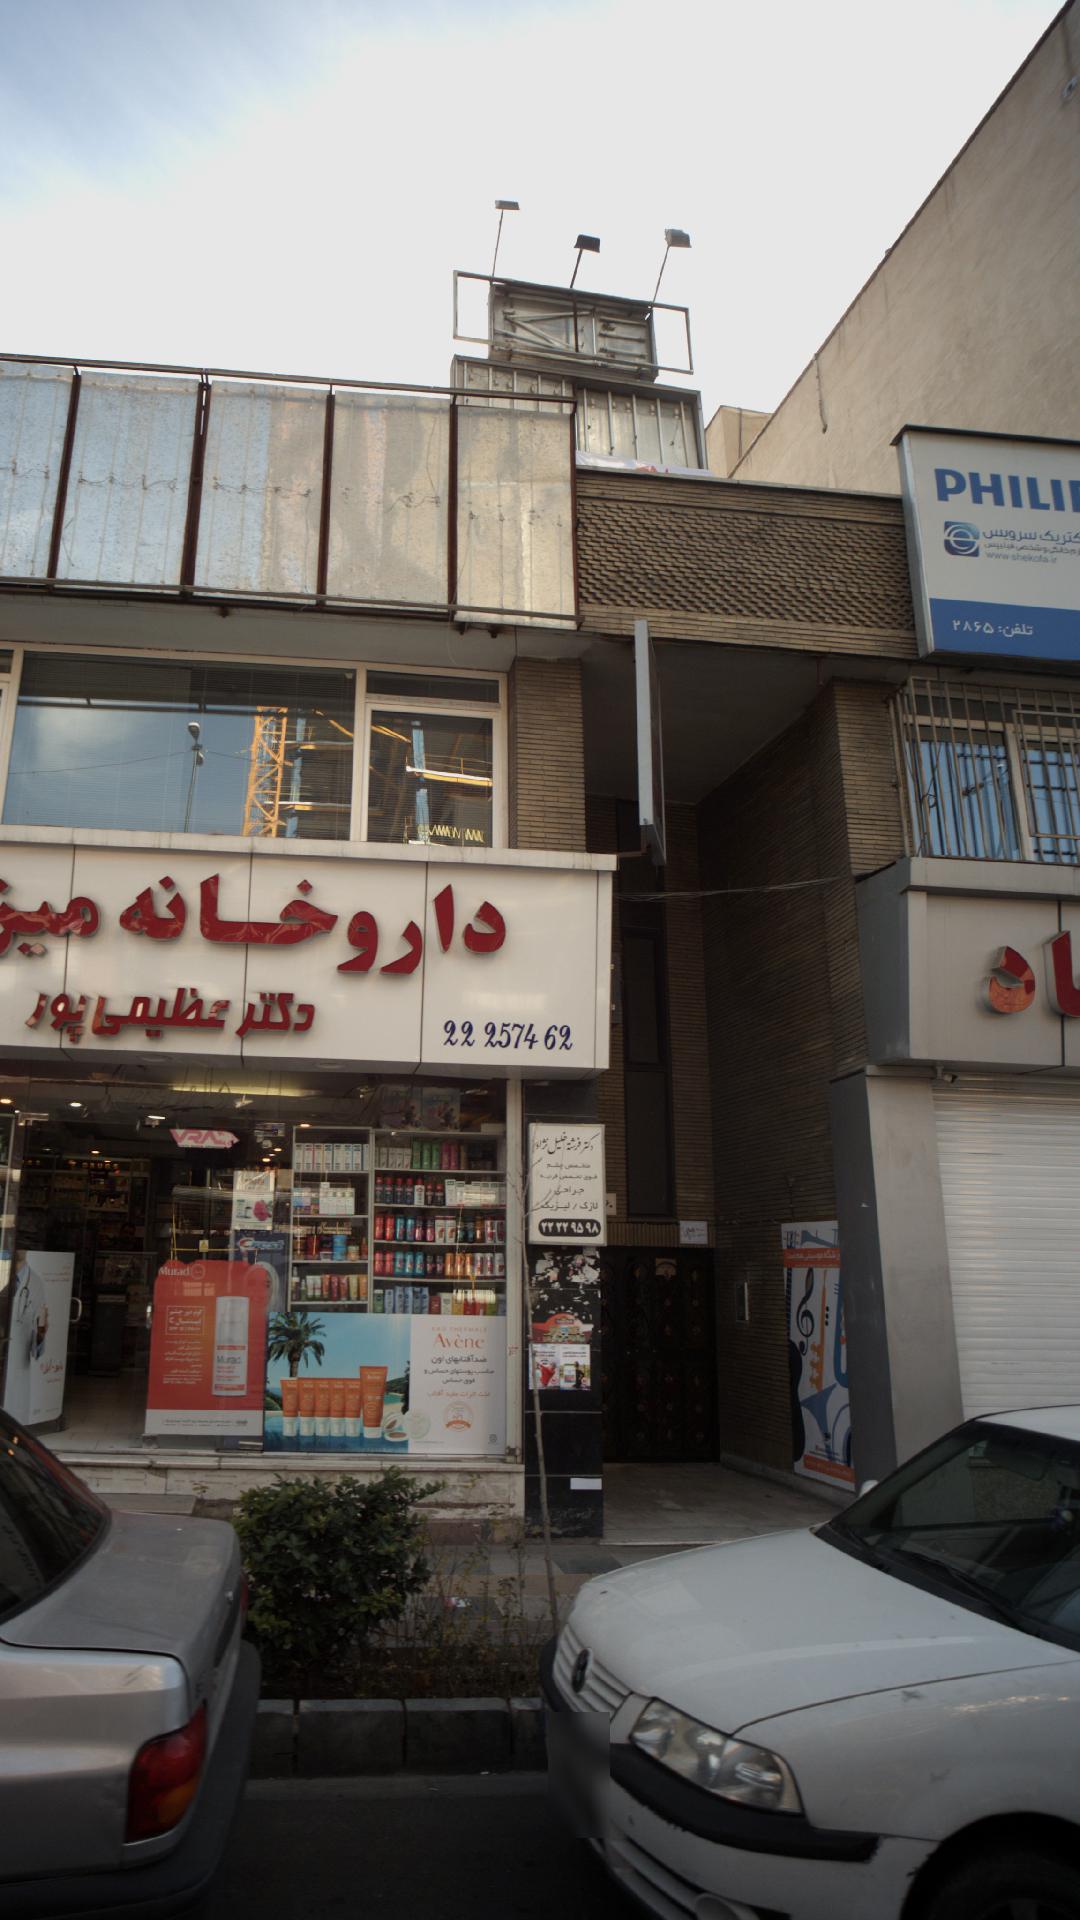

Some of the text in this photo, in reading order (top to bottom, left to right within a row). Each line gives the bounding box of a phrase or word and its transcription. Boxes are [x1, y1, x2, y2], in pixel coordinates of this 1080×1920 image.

[952, 620, 994, 633] ۲۸۶۵
[119, 873, 507, 974] داروخانه
[236, 992, 316, 1038] دکتر
[433, 1333, 485, 1349] Avène
